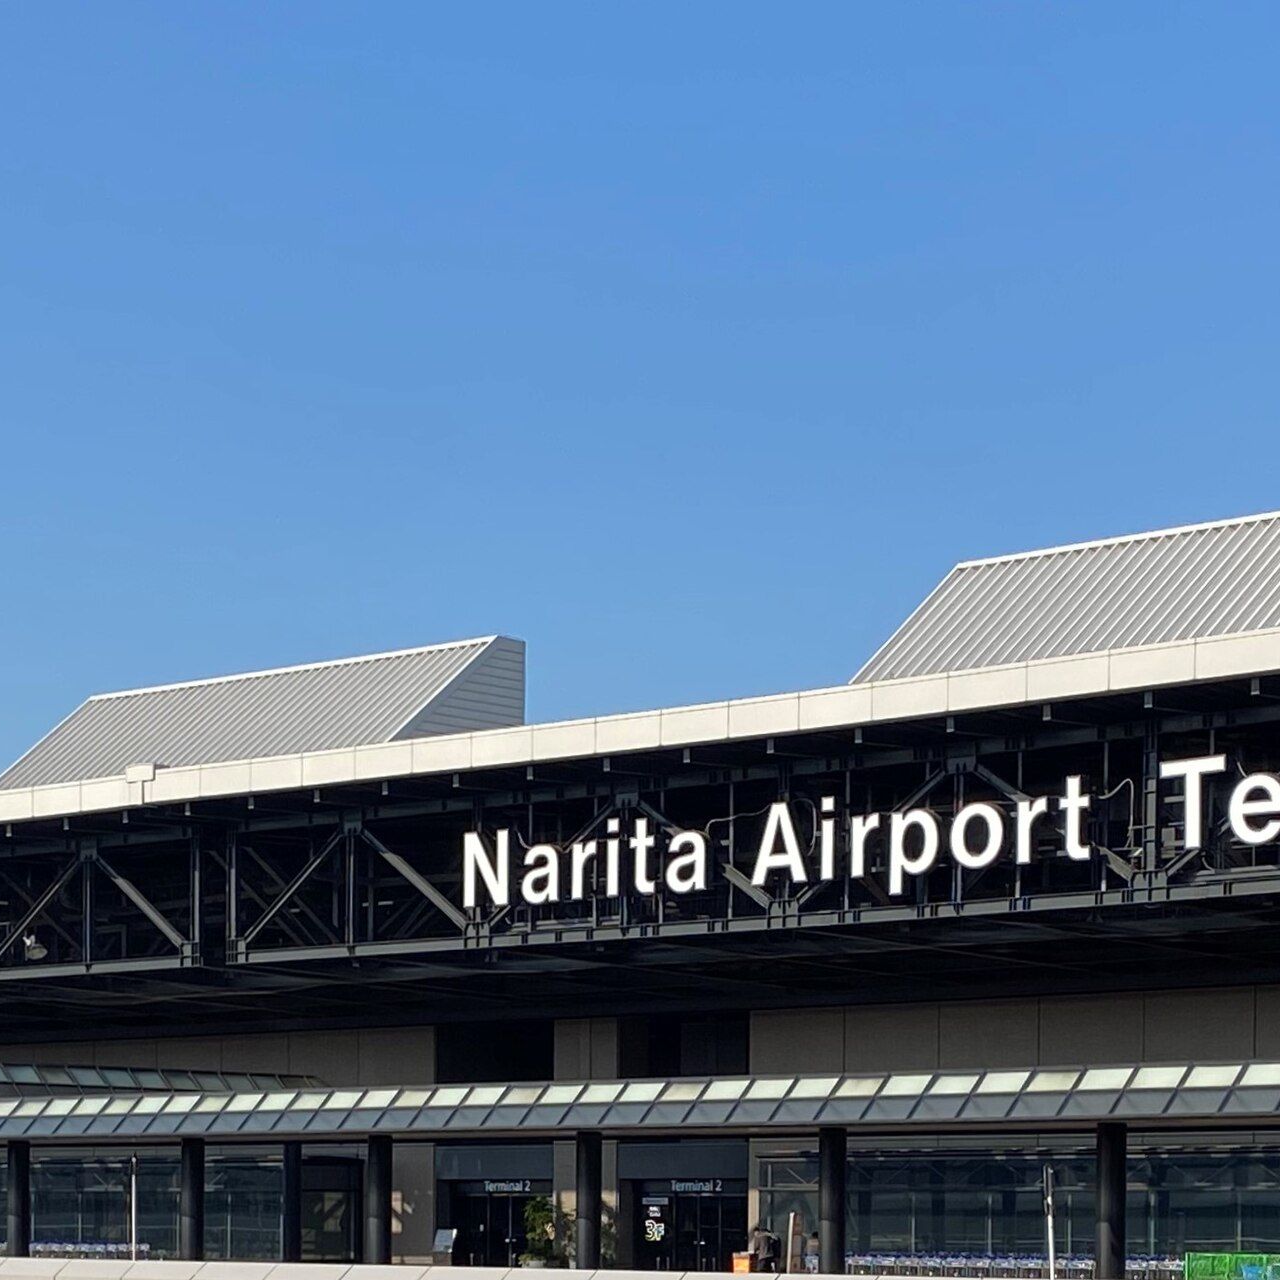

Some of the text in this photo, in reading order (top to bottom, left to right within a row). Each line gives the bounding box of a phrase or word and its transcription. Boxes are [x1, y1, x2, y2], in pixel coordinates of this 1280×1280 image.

[464, 817, 707, 908] Narita
[751, 774, 1092, 896] Airport
[483, 1180, 531, 1192] Terminal 2
[671, 1180, 722, 1191] Terminal 2
[645, 1220, 665, 1241] 3F
